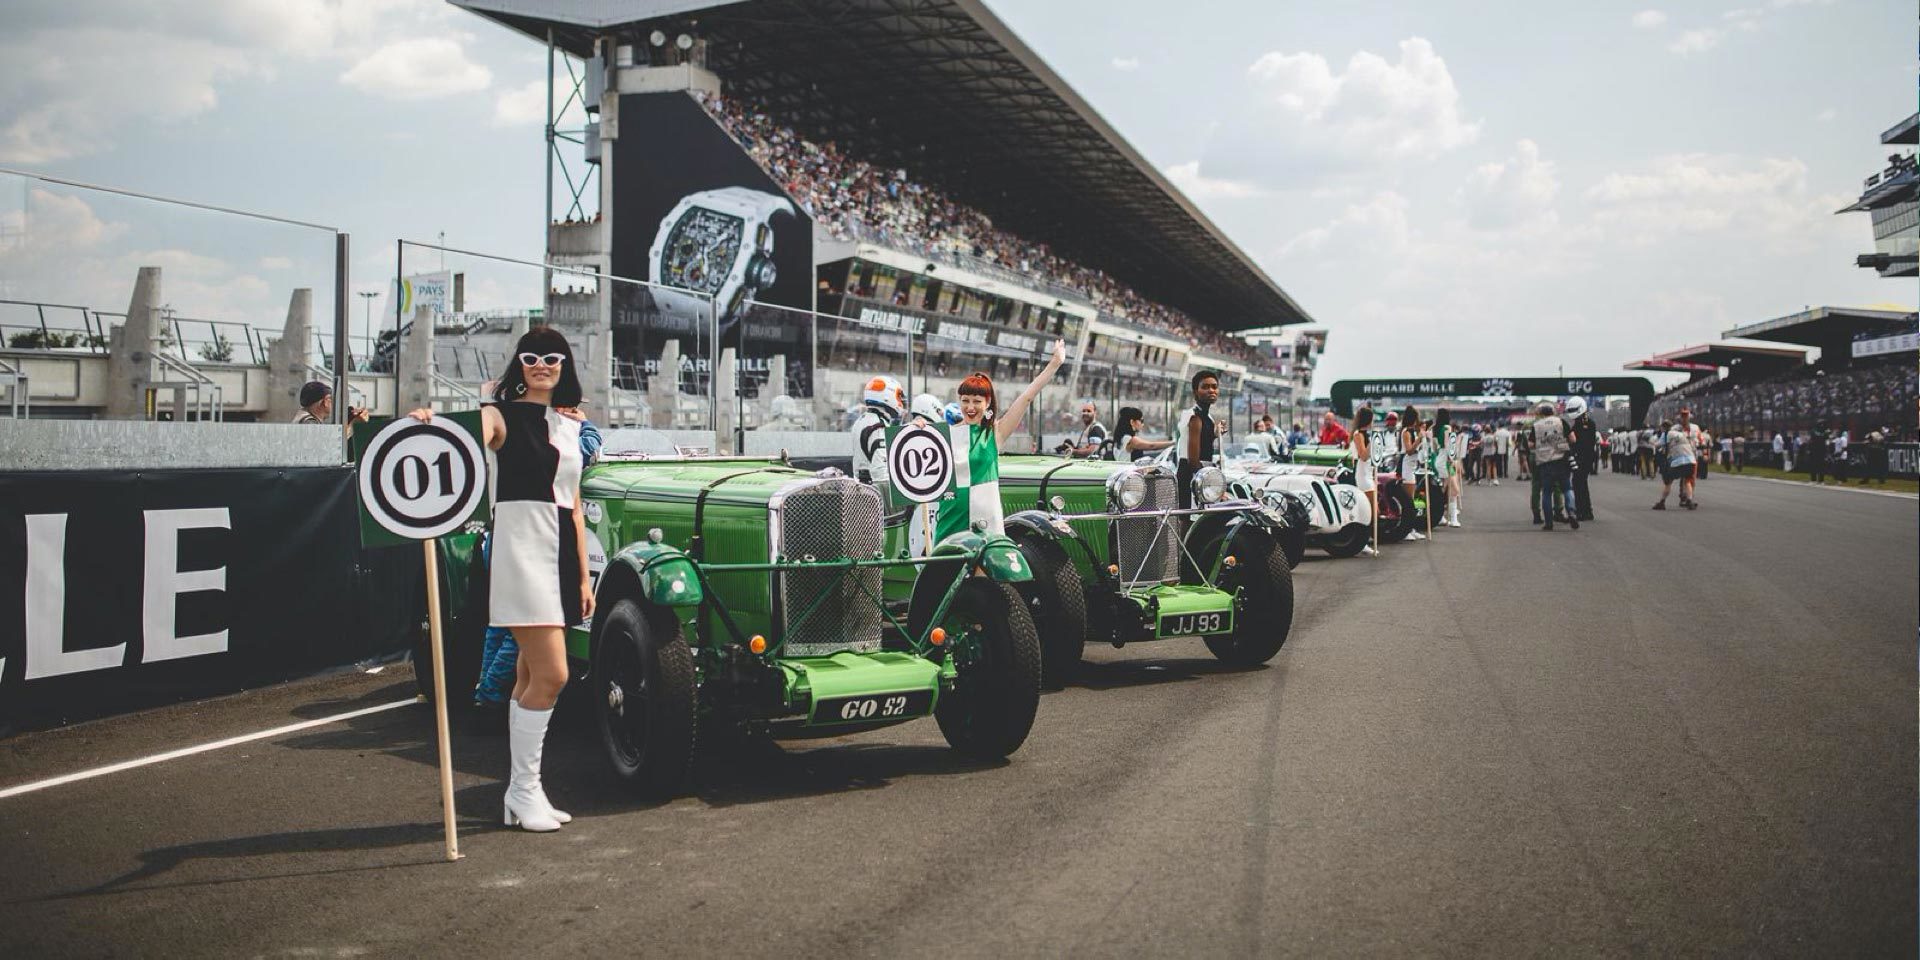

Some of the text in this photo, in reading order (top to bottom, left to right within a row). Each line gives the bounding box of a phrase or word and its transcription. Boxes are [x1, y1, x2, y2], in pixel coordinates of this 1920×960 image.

[418, 285, 445, 296] PAYS
[1363, 383, 1456, 394] RICHARD MILLE
[1568, 380, 1593, 393] EFG
[903, 447, 940, 479] 02
[392, 451, 455, 500] 01
[1171, 613, 1220, 635] JJ 93
[841, 696, 907, 720] GO 52
